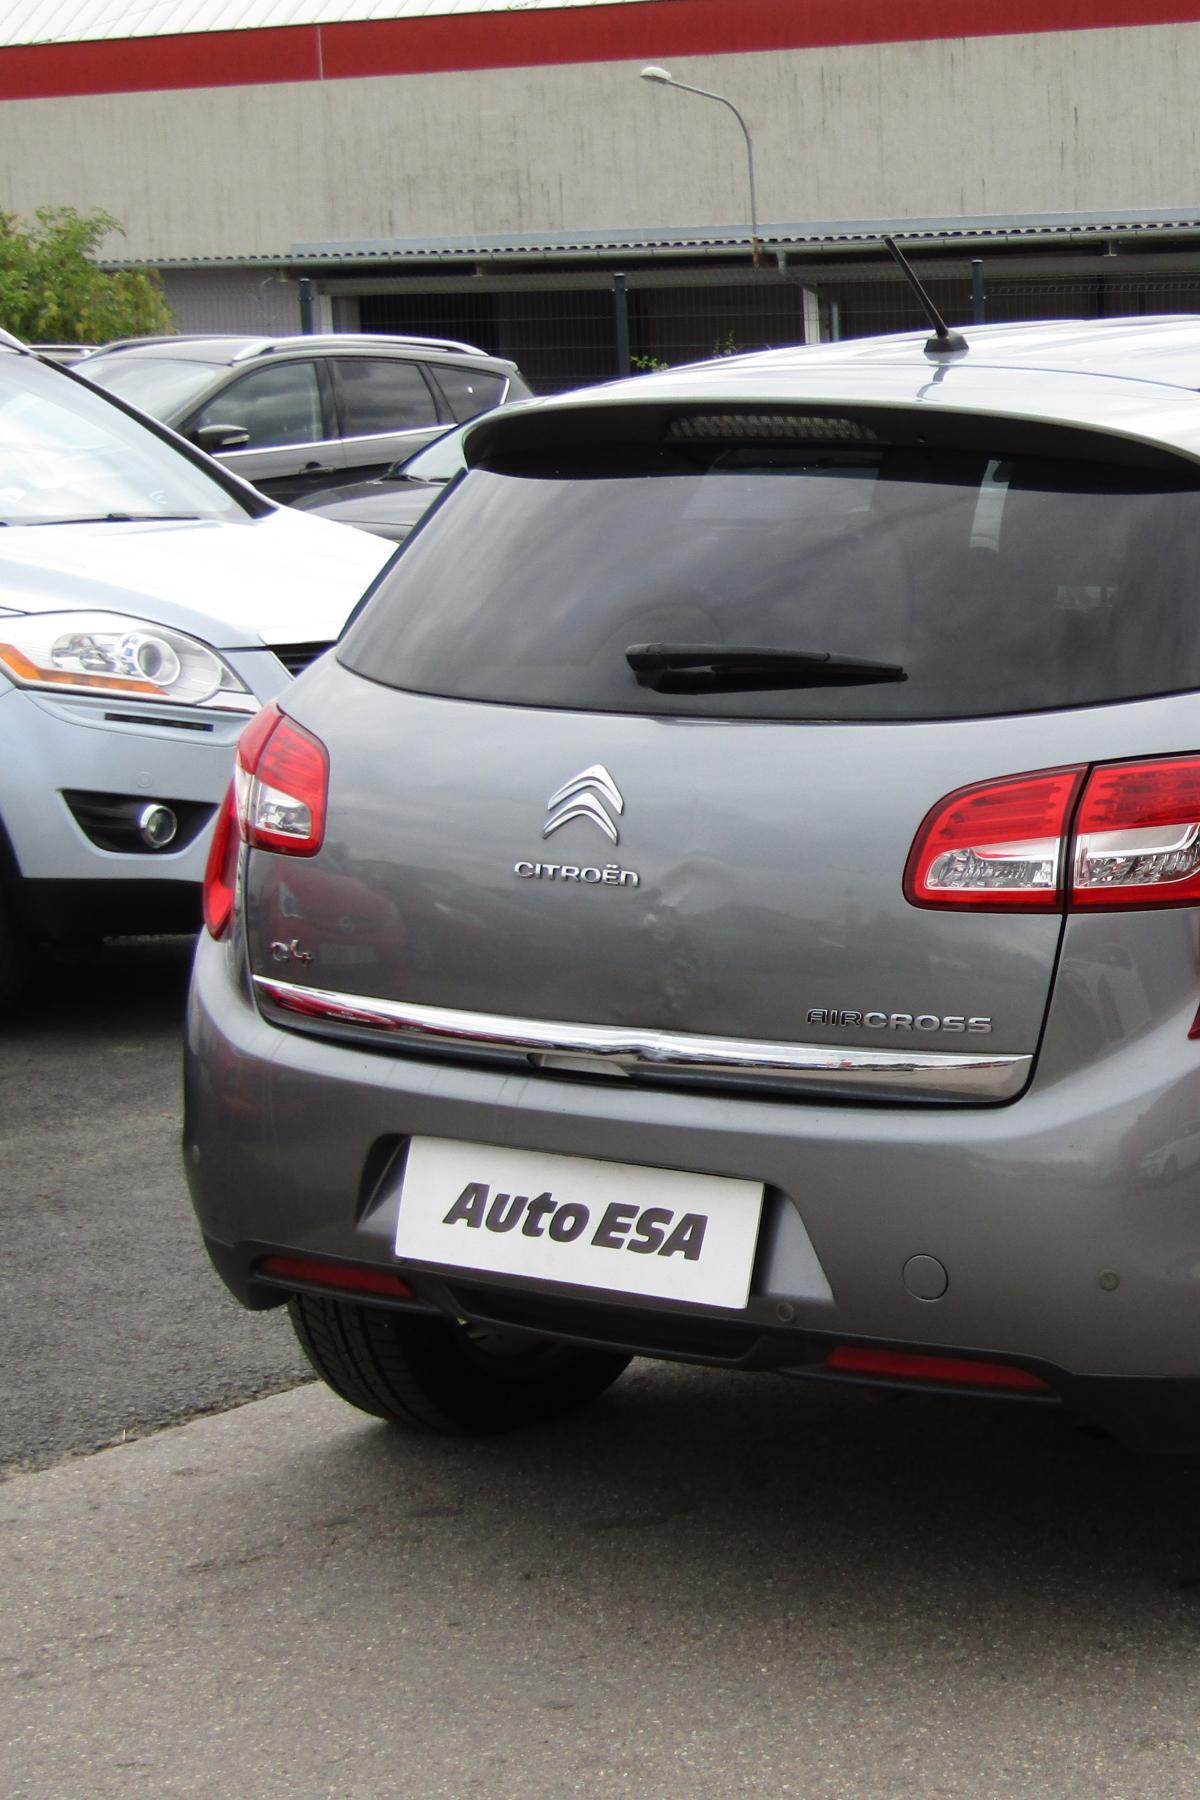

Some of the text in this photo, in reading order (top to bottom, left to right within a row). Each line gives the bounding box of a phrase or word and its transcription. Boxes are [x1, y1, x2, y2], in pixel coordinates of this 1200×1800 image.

[514, 861, 641, 888] CITROËN
[807, 1008, 993, 1034] AIRCROSS
[442, 1182, 709, 1261] Auto ESA
